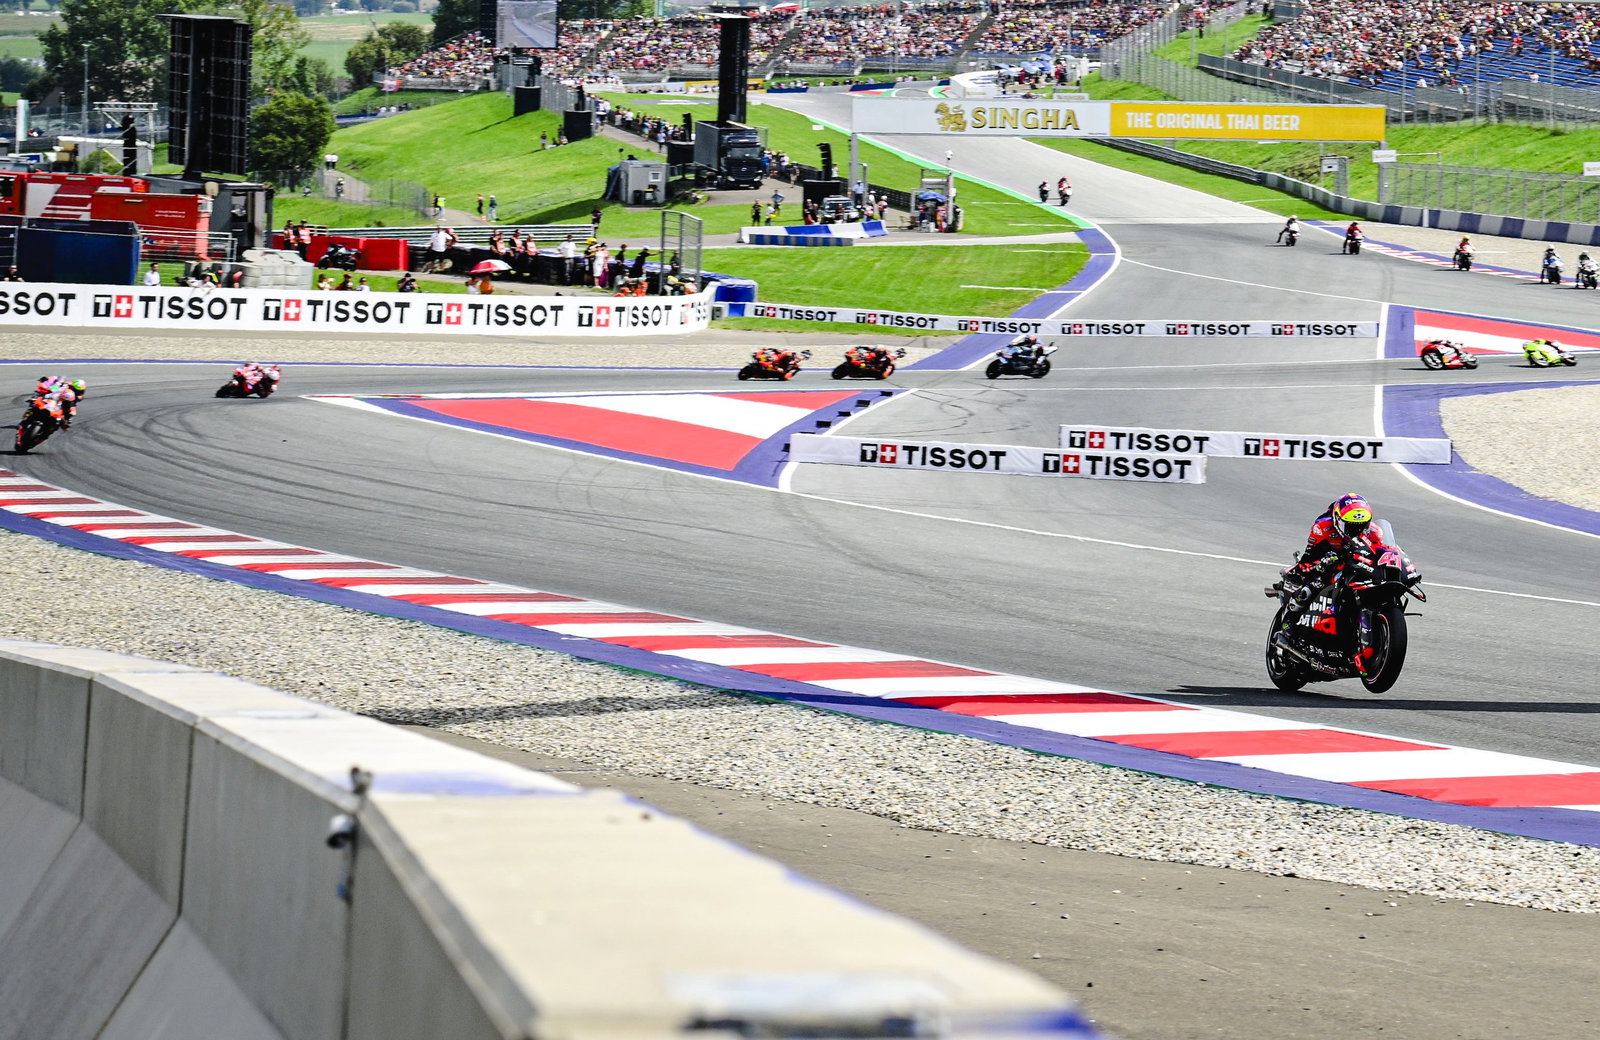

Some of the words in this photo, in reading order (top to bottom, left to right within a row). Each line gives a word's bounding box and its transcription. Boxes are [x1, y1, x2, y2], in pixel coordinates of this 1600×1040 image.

[971, 106, 1080, 130] SINGHA
[1126, 112, 1153, 128] THE
[1156, 112, 1223, 129] ORIGINAL
[1227, 113, 1259, 130] THAI
[1263, 114, 1300, 131] BEER
[139, 295, 247, 320] TISSOT
[307, 299, 410, 324] TISSOT
[467, 303, 564, 327] TISSOT
[615, 304, 672, 327] TISSOT
[778, 307, 837, 322] TISSOT
[879, 313, 939, 329] TISSOT
[982, 320, 1042, 334] TISSOT
[1085, 323, 1146, 335] TISSOT
[1190, 323, 1251, 336] TISSOT
[1295, 324, 1357, 336] TISSOT
[1110, 431, 1209, 454] TISSOT
[1284, 439, 1383, 459] TISSOT
[902, 445, 1007, 470] TISSOT
[1086, 455, 1191, 480] TISSOT
